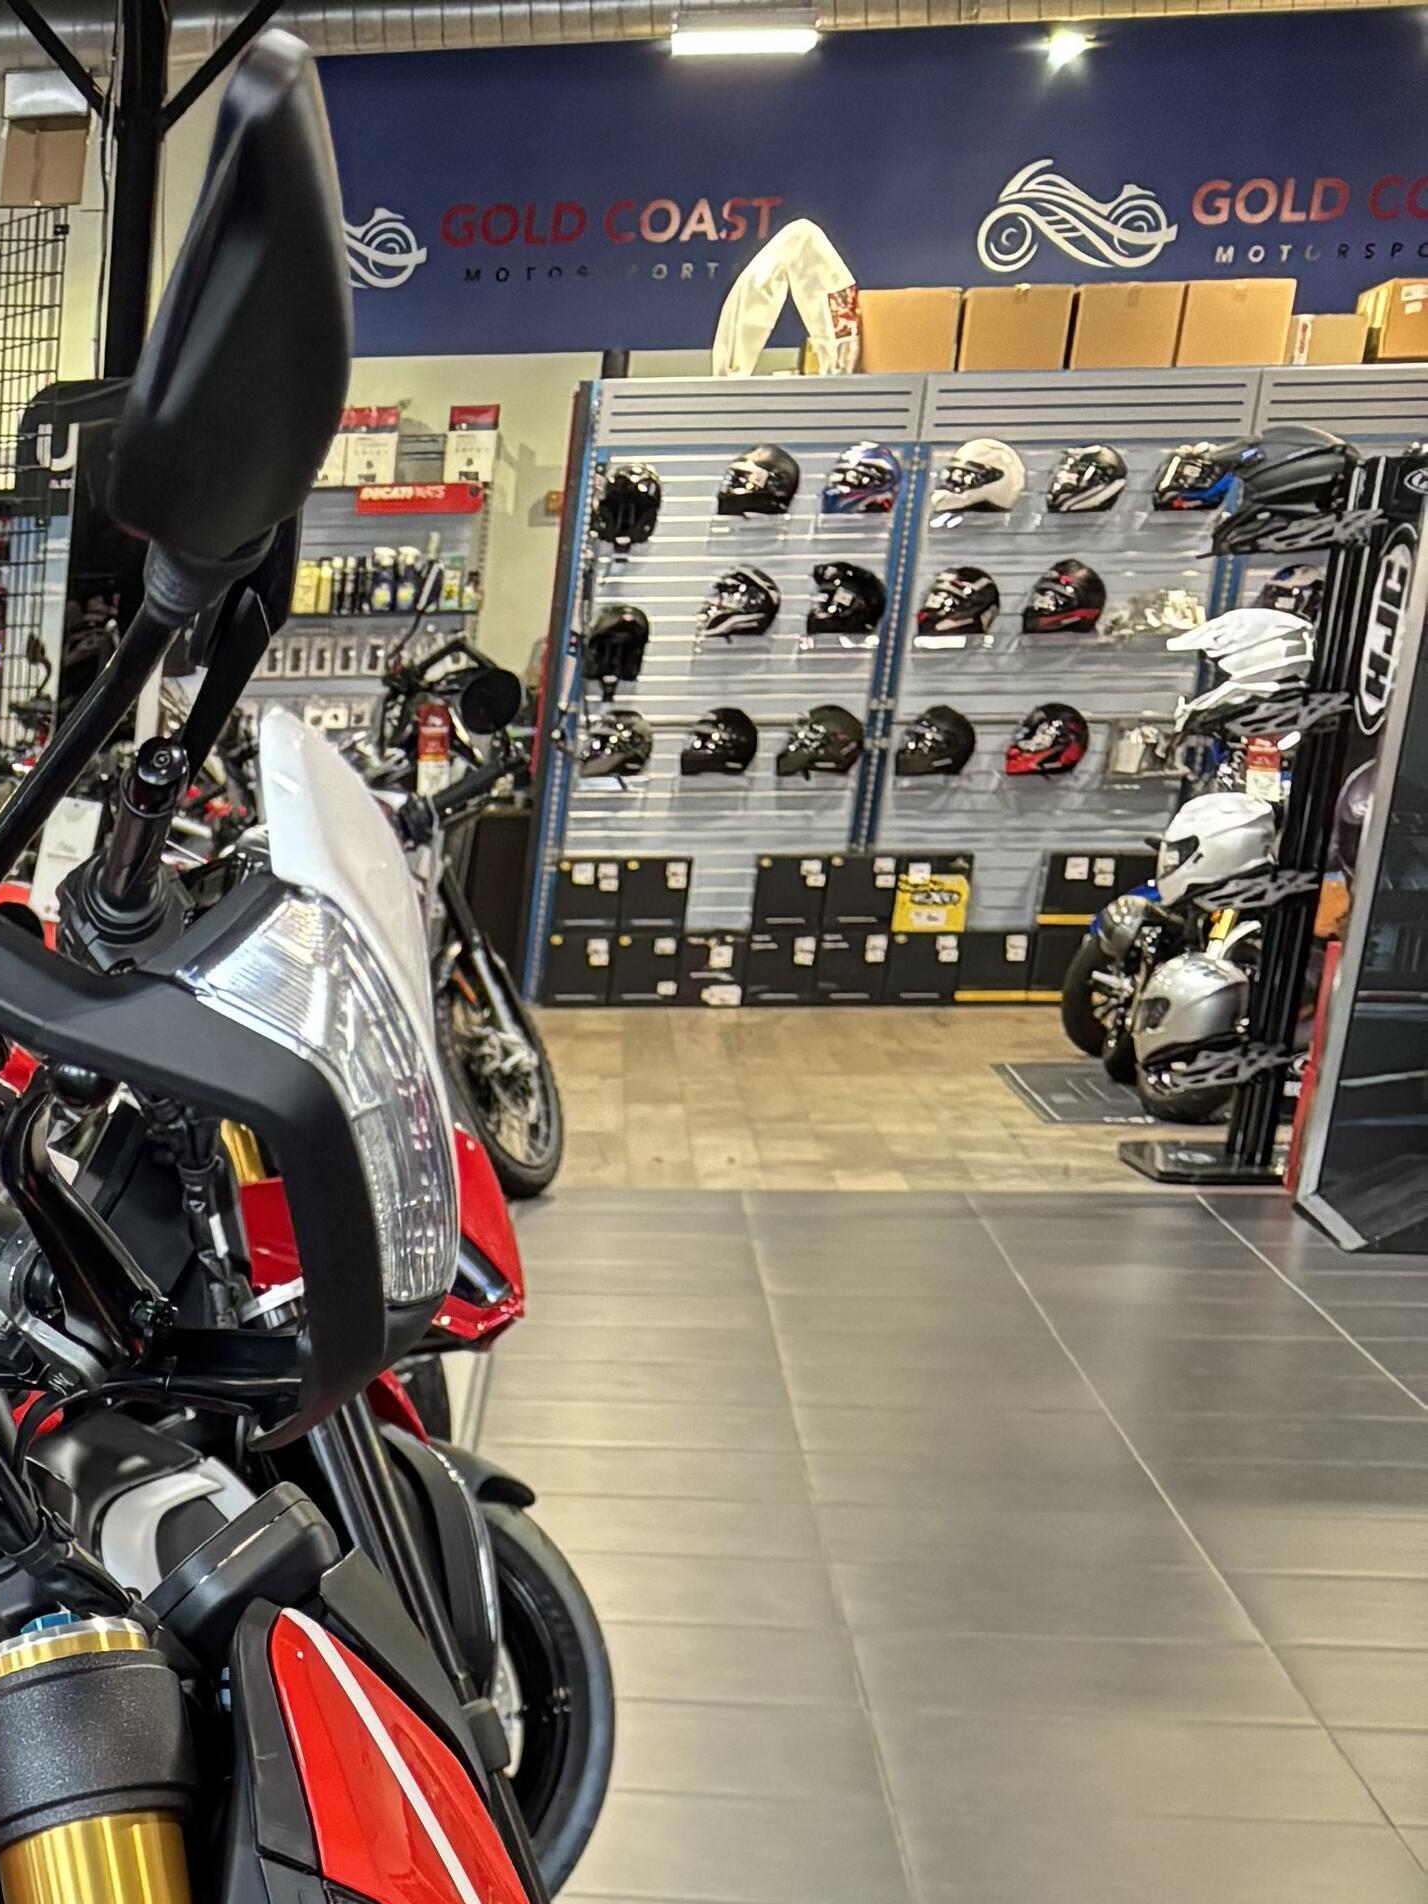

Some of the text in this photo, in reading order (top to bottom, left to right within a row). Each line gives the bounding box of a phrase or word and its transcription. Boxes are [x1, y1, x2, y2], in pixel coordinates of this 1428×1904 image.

[441, 196, 784, 247] GOLD COAST
[1192, 178, 1350, 225] GOLD
[1366, 562, 1408, 700] HJC
